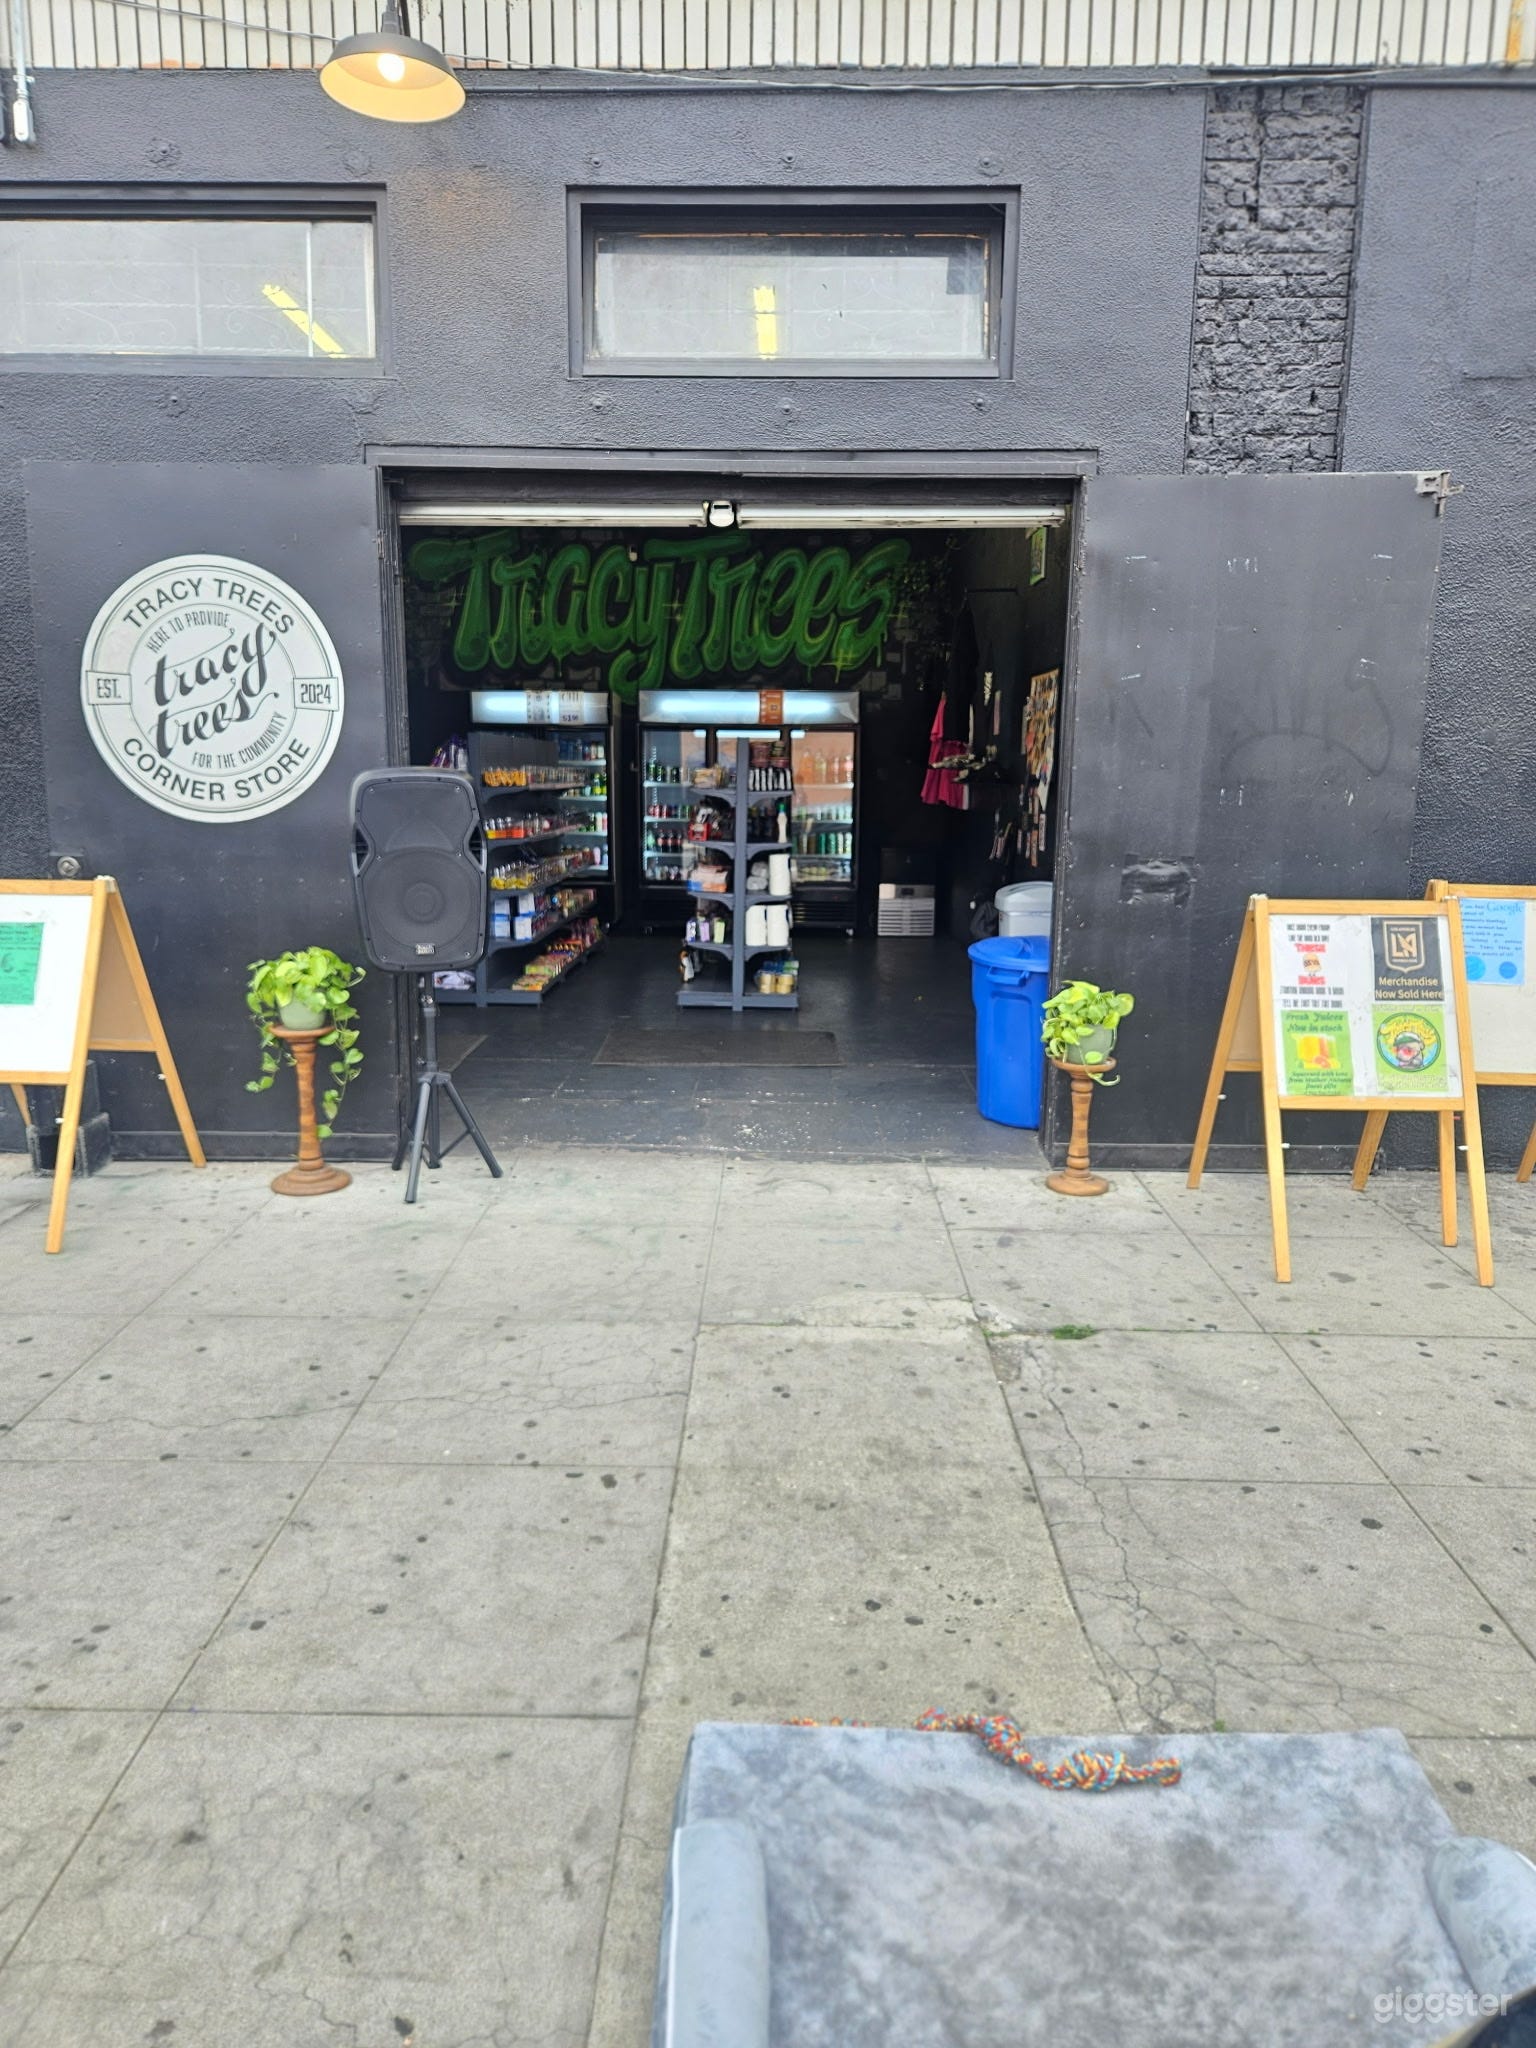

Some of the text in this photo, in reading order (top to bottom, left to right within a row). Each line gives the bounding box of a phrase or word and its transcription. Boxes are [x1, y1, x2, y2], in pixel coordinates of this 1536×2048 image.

[123, 577, 295, 635] TRACY TREES
[146, 610, 231, 654] HERE TO PROVIDE
[96, 678, 122, 700] EST.
[145, 622, 276, 707] tracy
[147, 680, 280, 759] trees
[300, 683, 332, 705] 2024
[192, 711, 288, 769] FOR THE COMMUNITY
[123, 738, 311, 802] CORNER STORE
[1375, 989, 1443, 999] Now Sold Here
[1378, 976, 1439, 986] Merchandise
